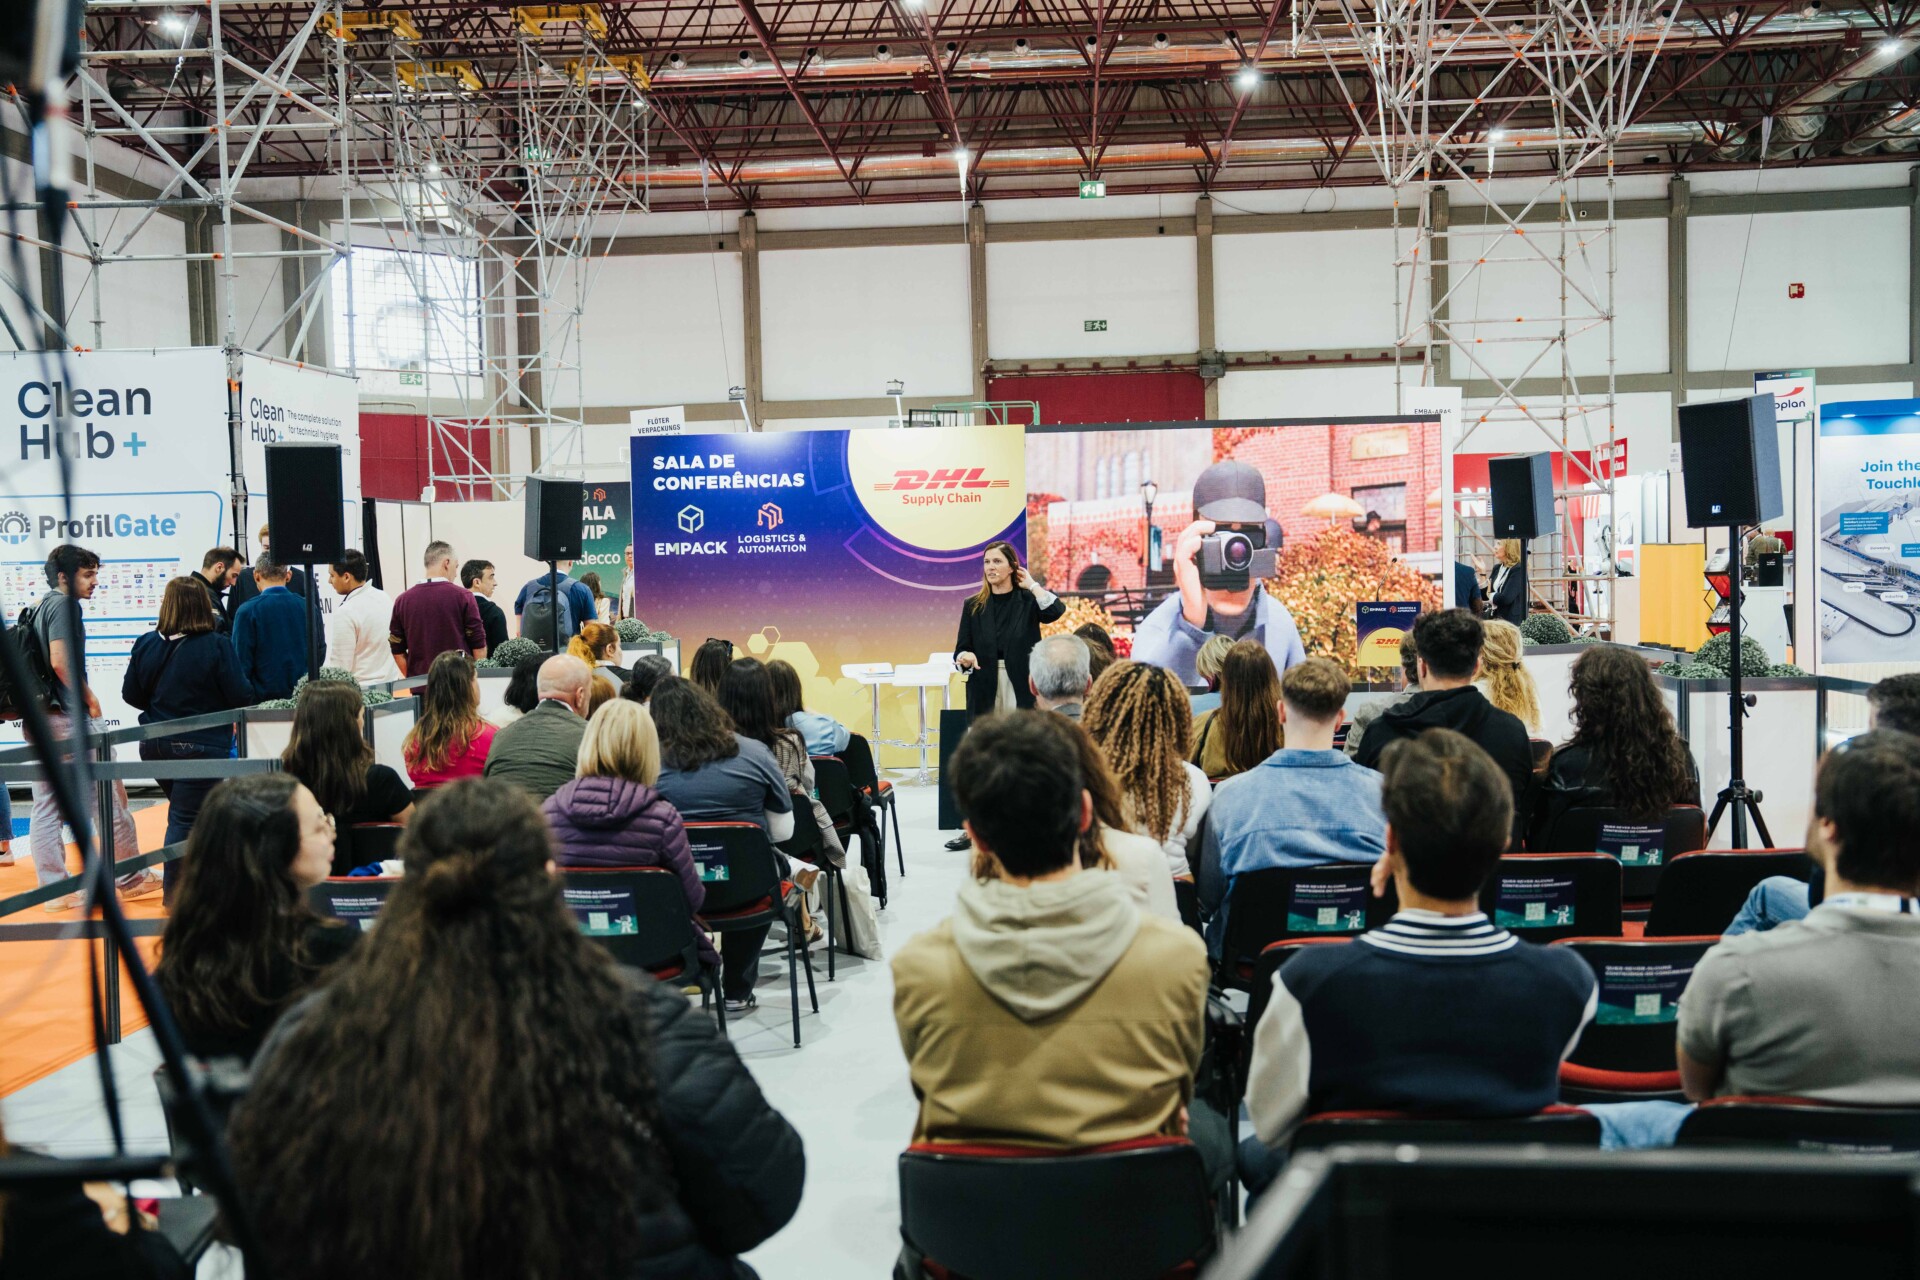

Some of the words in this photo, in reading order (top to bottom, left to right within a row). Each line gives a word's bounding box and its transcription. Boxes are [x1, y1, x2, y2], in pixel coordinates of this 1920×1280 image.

[18, 381, 151, 418] Clean
[1775, 400, 1806, 411] oplan
[250, 397, 284, 422] Clean
[298, 413, 321, 424] complete
[322, 417, 341, 427] solution
[638, 424, 680, 434] VERPACKUNGS
[653, 455, 705, 470] SALA
[709, 454, 735, 468] DE
[1861, 460, 1893, 472] Join
[653, 471, 805, 490] CONFERÊNCIAS
[892, 468, 991, 490] DHL
[902, 493, 944, 506] Supply
[947, 492, 981, 503] Chain
[583, 505, 616, 520] ALA
[738, 534, 795, 543] LOGISTICS
[799, 534, 806, 542] &
[655, 541, 728, 555] EMPACK
[738, 544, 807, 553] AUTOMATION
